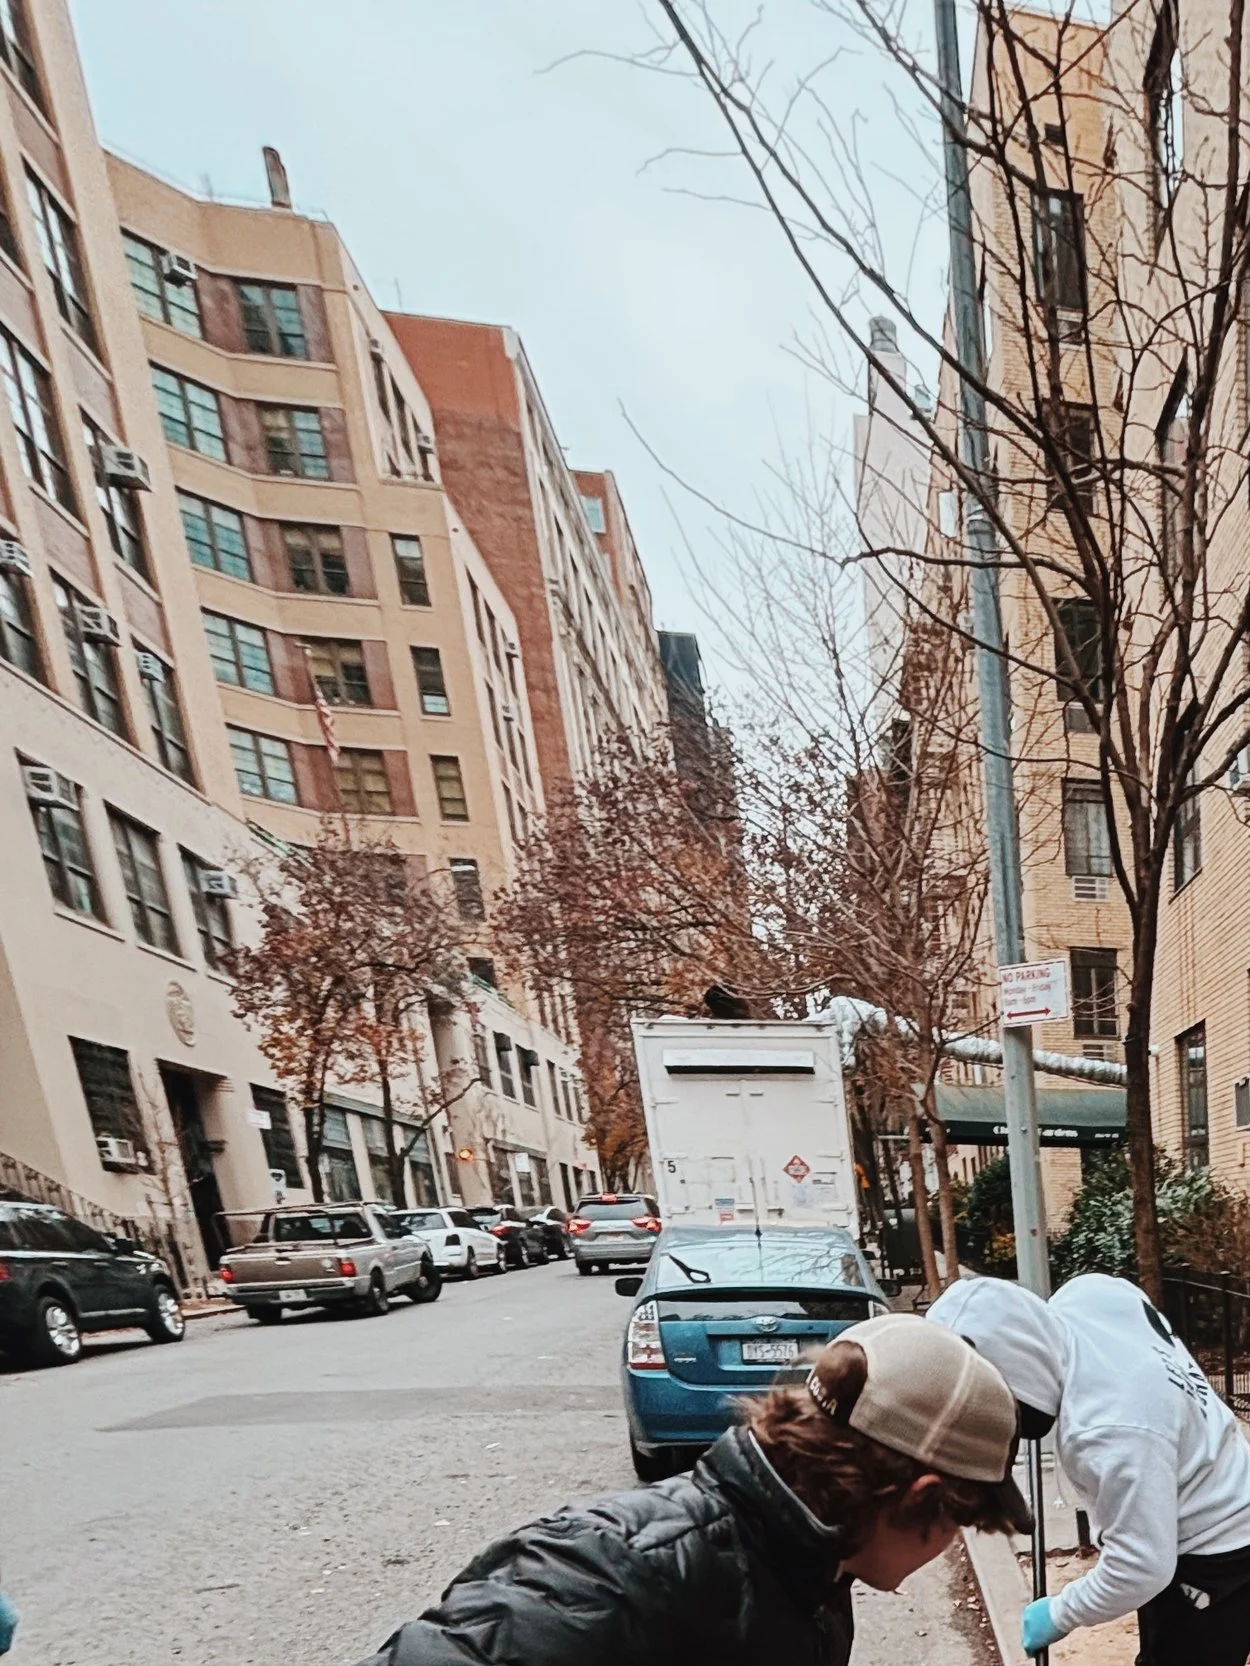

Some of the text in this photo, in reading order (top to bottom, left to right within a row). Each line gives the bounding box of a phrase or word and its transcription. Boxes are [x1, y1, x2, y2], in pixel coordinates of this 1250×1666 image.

[1003, 967, 1051, 983] NO PARKING
[667, 1160, 677, 1174] 5
